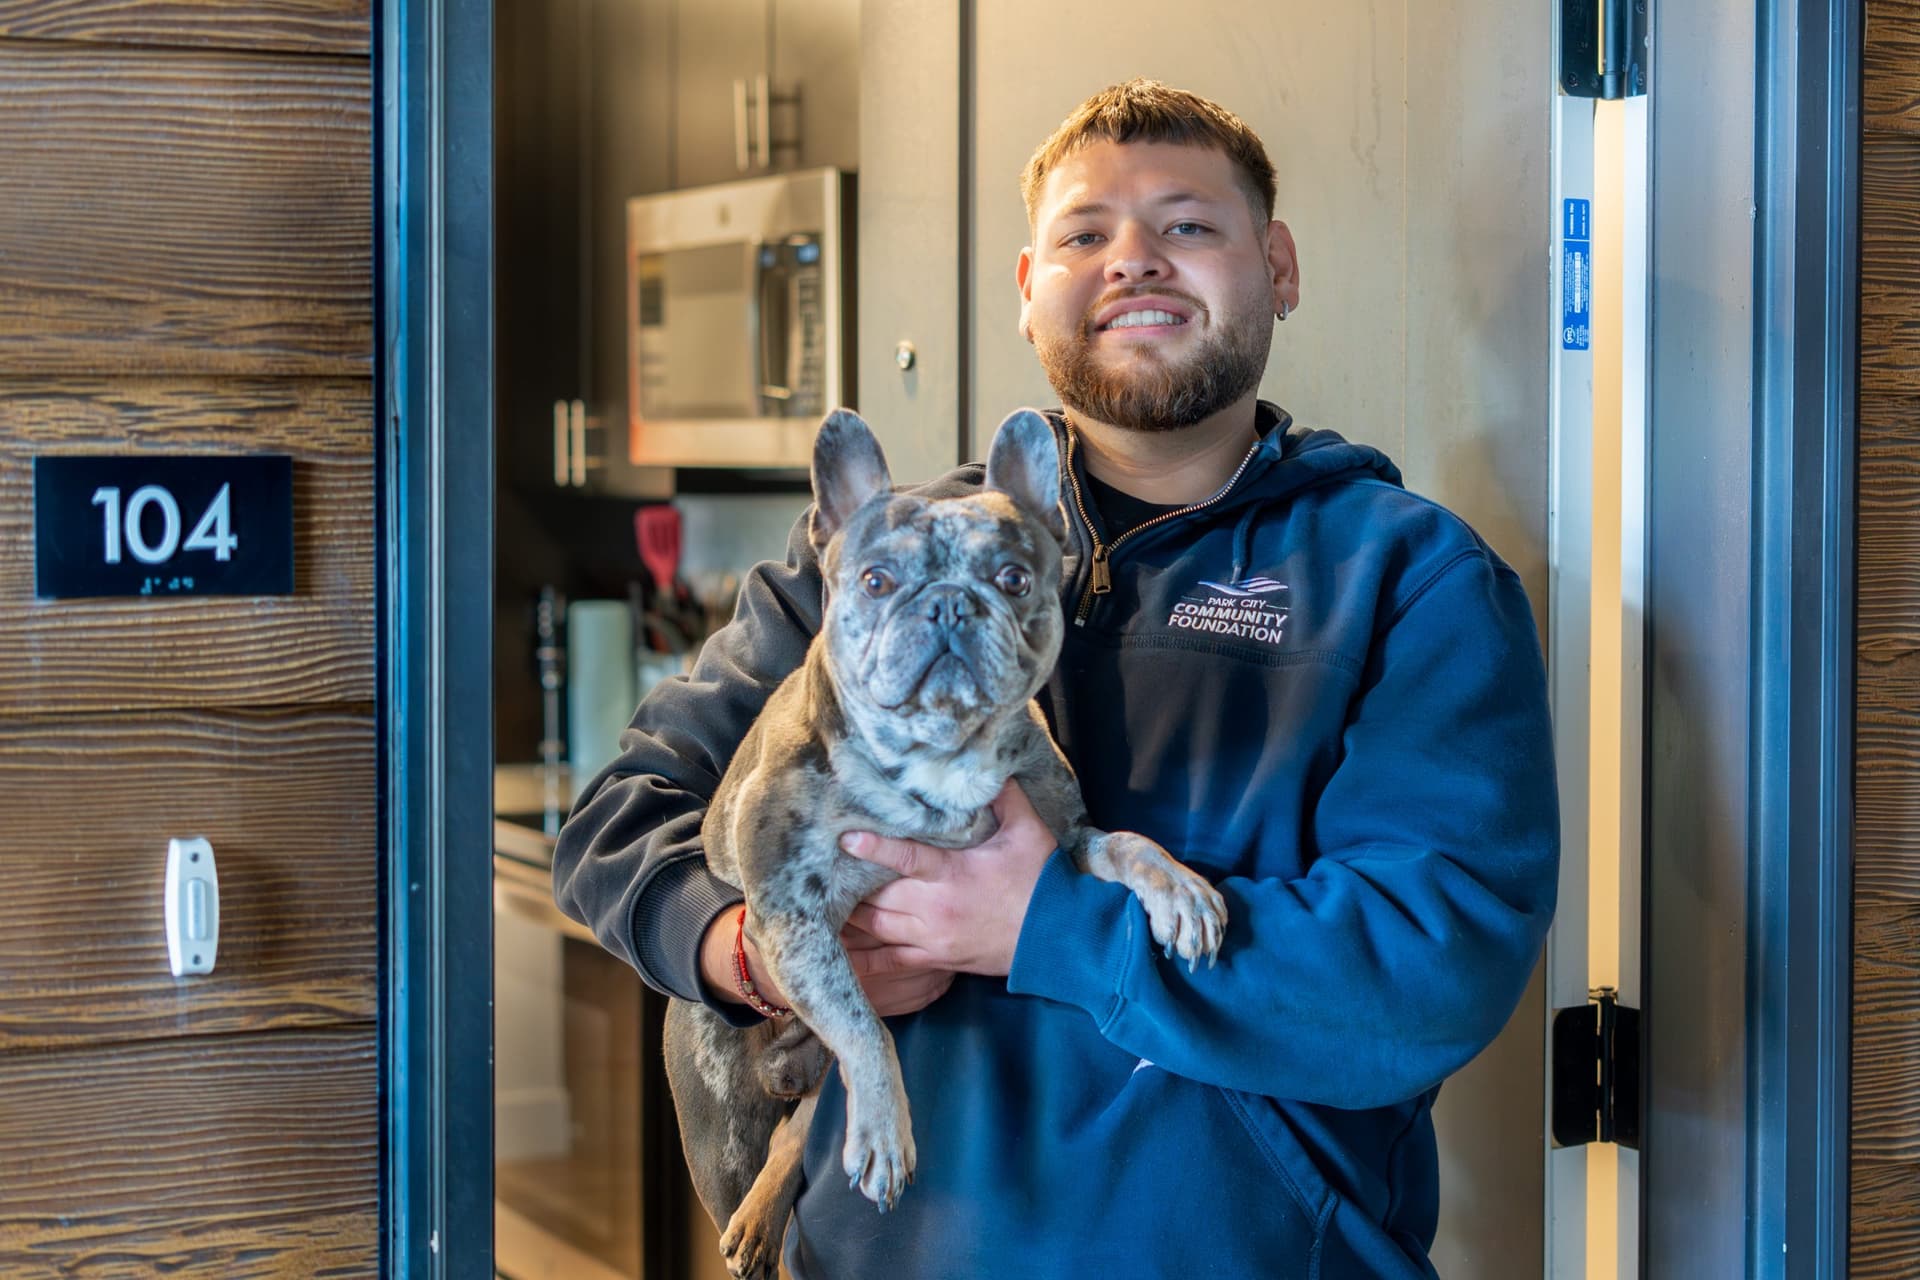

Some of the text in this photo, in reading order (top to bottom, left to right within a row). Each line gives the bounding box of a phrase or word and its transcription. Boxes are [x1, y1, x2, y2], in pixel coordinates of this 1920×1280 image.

[91, 482, 238, 564] 104
[1174, 603, 1288, 628] COMMUNITY
[1207, 597, 1267, 609] PARK CITY
[1168, 614, 1283, 644] FOUNDATION
